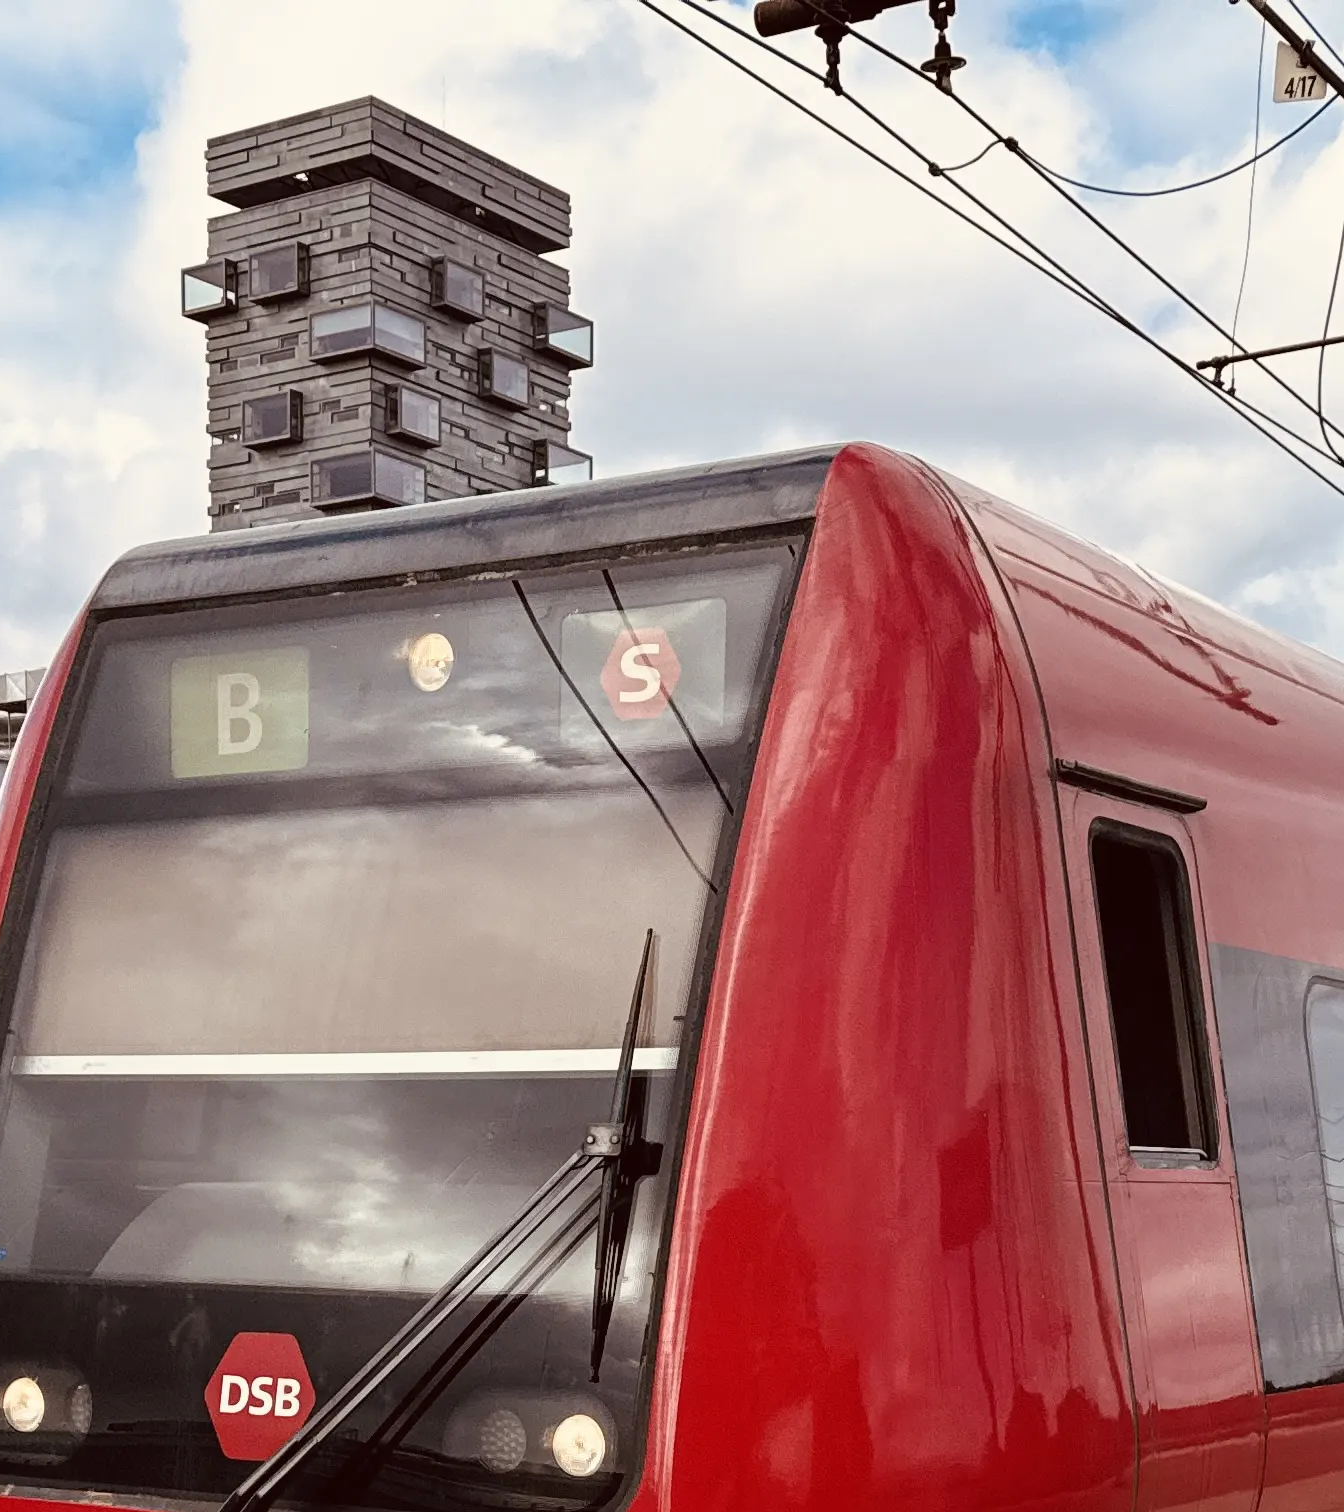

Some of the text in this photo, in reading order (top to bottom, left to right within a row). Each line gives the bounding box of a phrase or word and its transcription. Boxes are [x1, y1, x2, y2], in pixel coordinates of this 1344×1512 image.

[1284, 75, 1317, 98] 4/17
[618, 643, 661, 703] S
[216, 672, 263, 756] B
[219, 1374, 301, 1417] DSB
